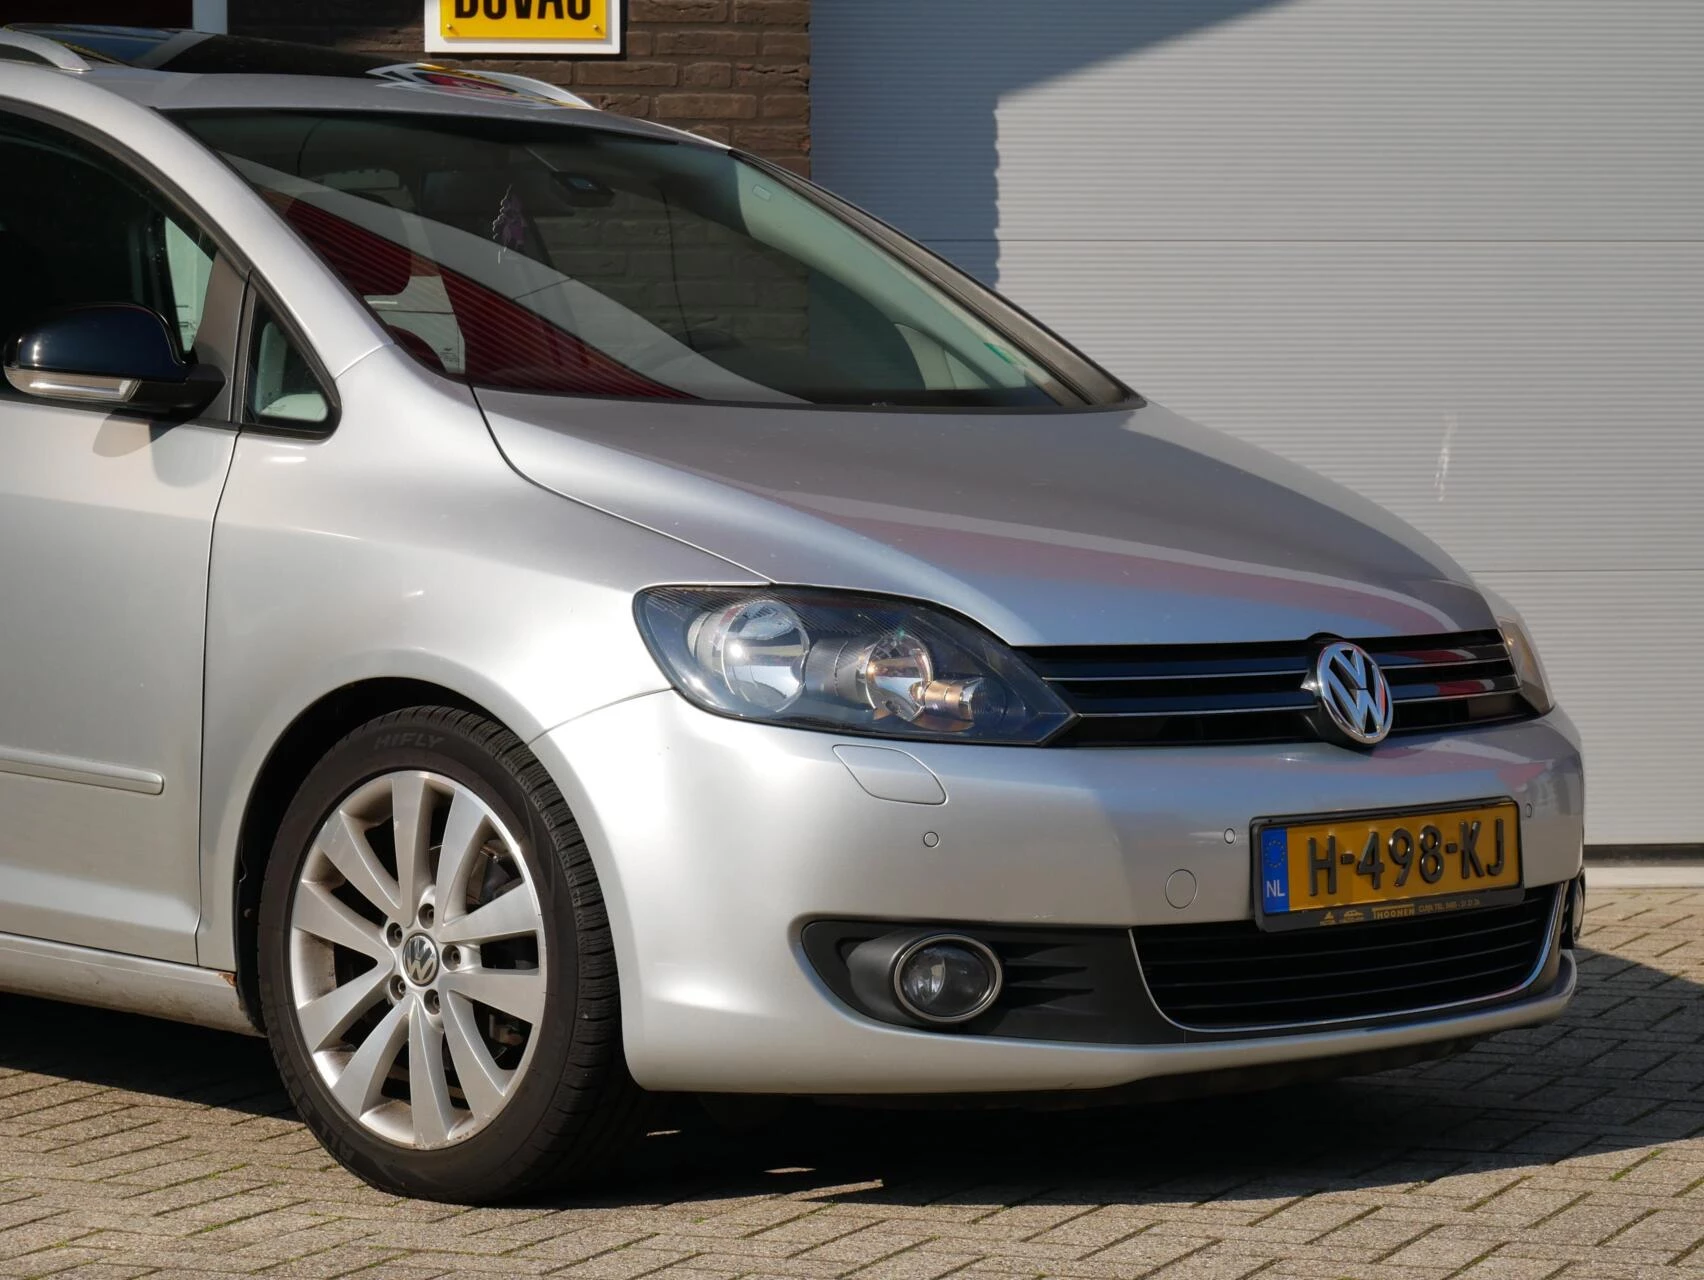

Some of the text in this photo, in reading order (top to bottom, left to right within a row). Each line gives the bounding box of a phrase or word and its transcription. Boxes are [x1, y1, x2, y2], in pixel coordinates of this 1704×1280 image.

[373, 731, 446, 751] HIFLY
[1307, 818, 1504, 897] H-498-KJ
[1266, 880, 1286, 898] NL
